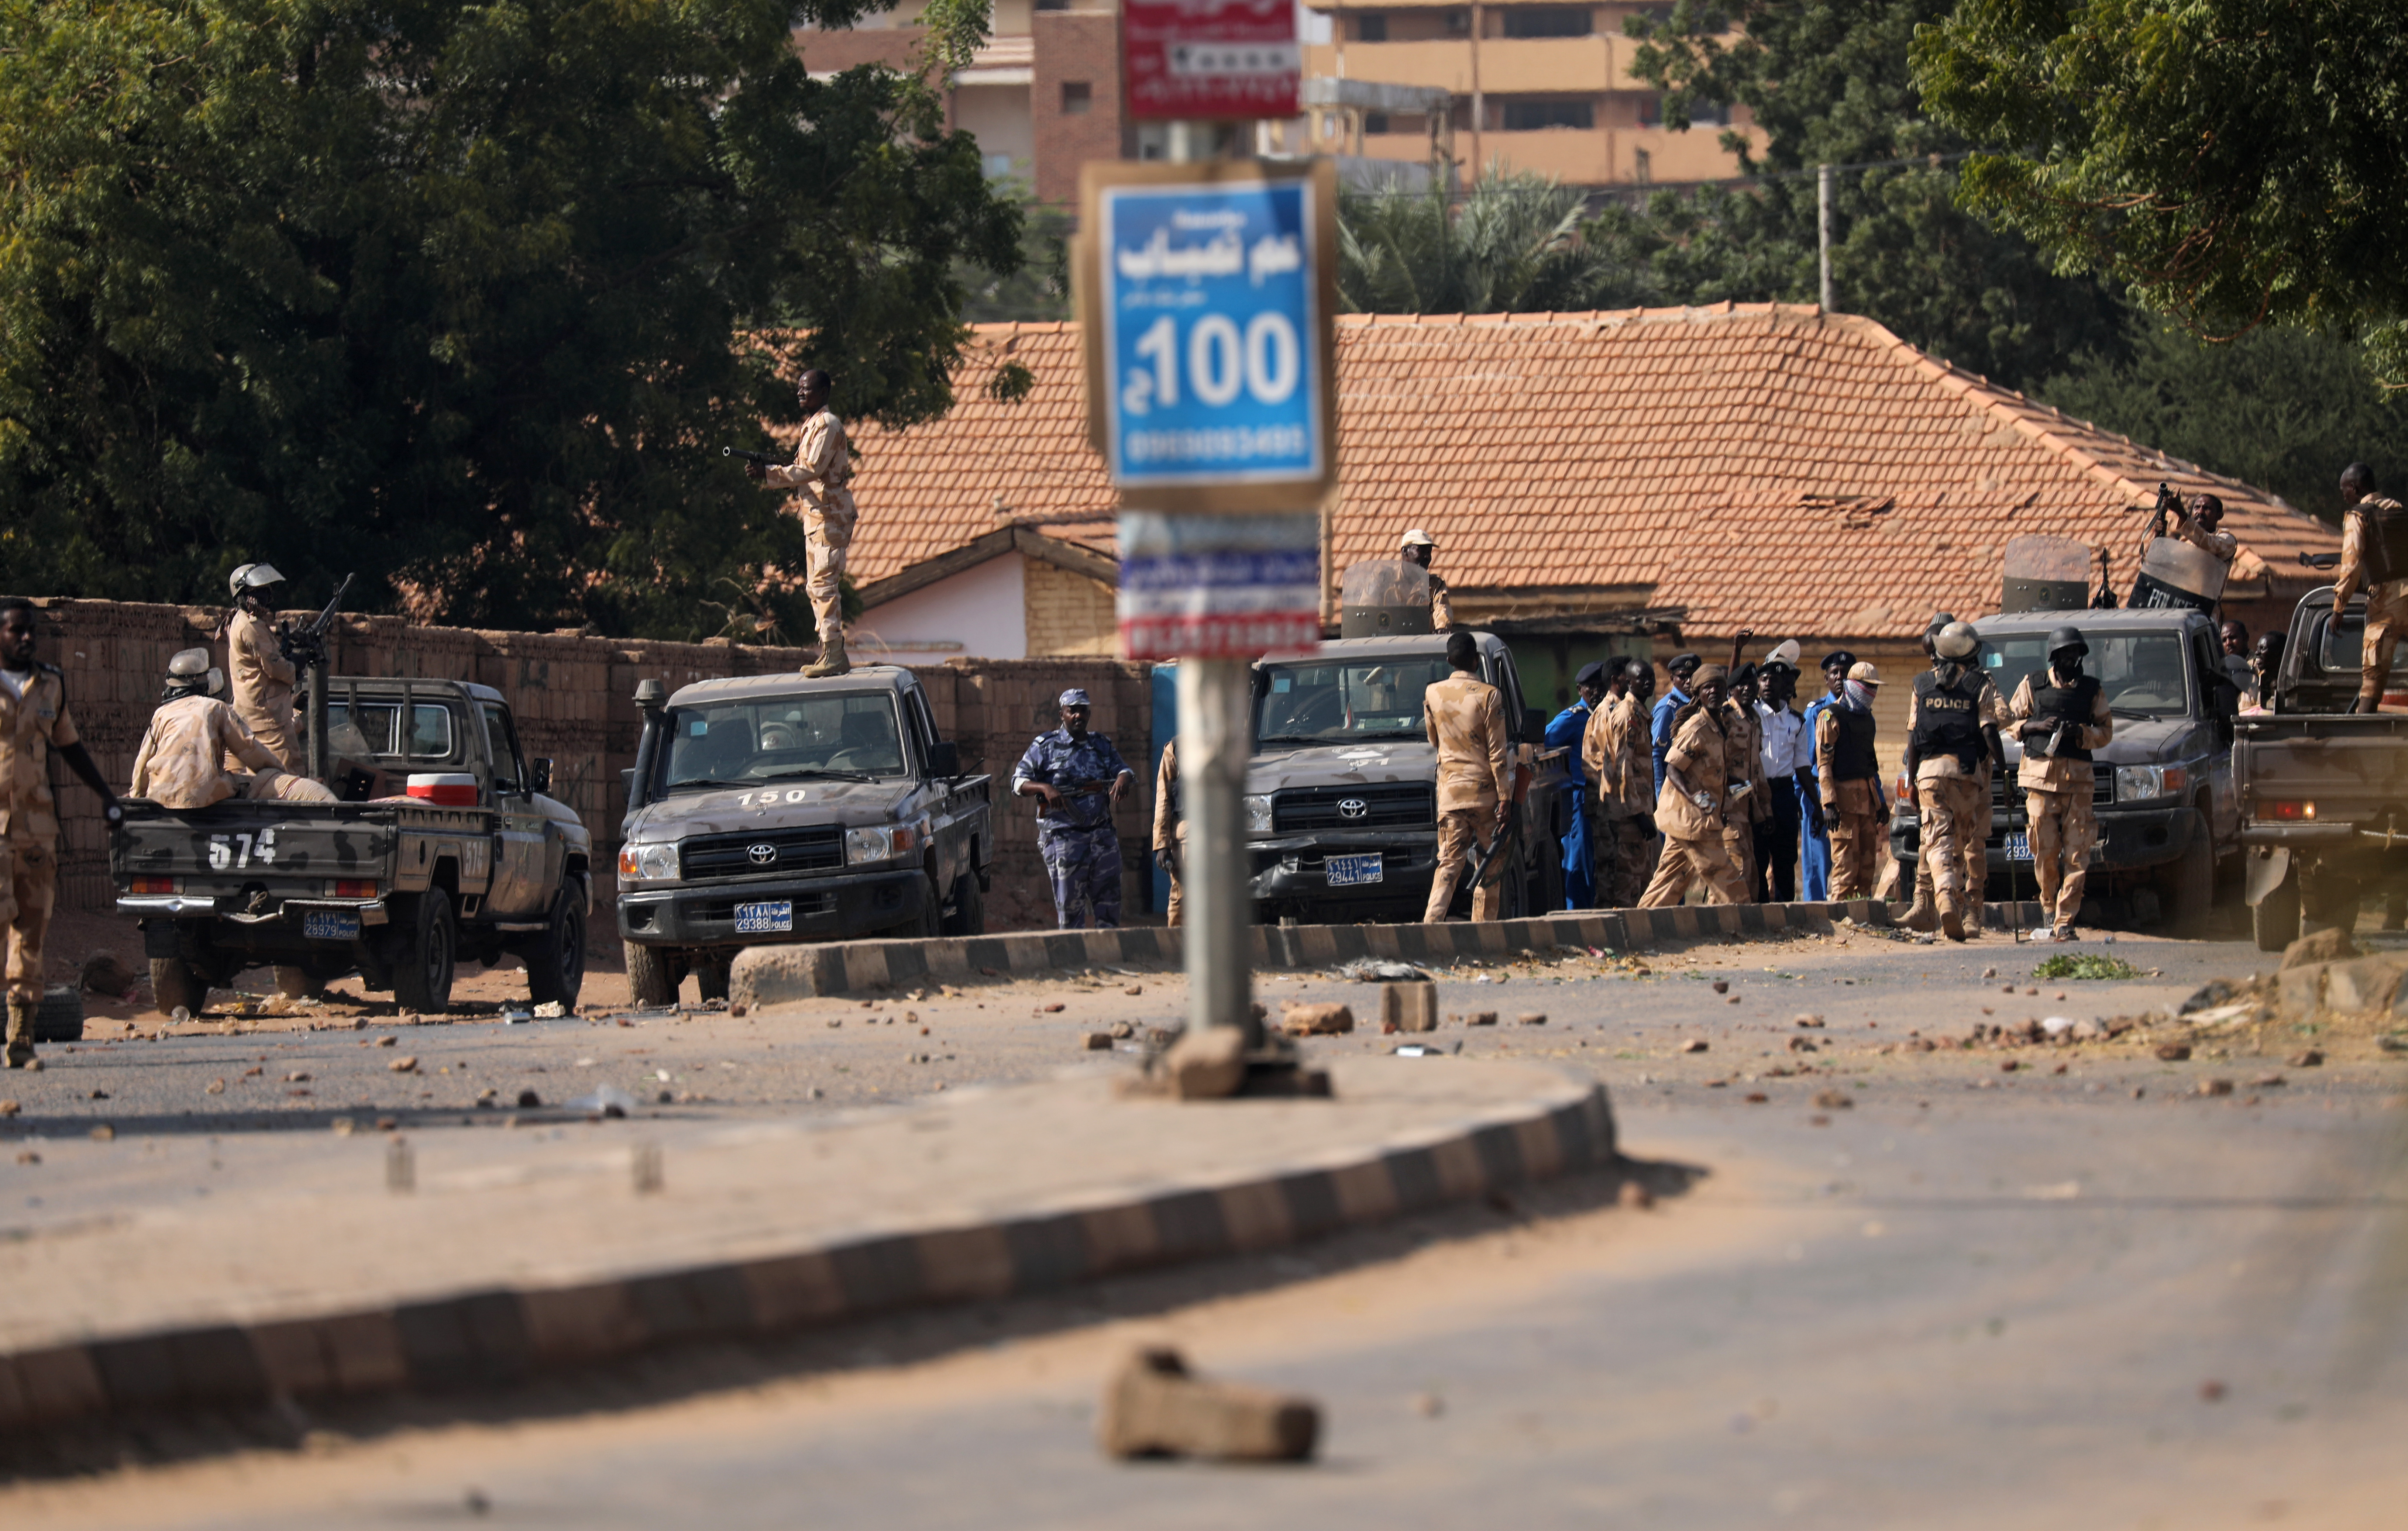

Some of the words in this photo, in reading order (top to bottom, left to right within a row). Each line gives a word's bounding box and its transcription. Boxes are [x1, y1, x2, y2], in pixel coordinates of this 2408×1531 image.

[1137, 312, 1298, 405] 100
[1926, 697, 1970, 710] POLICE
[737, 789, 806, 806] 150
[209, 828, 276, 870] 574
[2007, 845, 2033, 858] 2937
[1329, 869, 1360, 884] 29441
[1363, 872, 1381, 881] POLICE
[771, 907, 790, 917] الشرطة
[306, 924, 337, 936] 28979
[737, 917, 769, 930] 29388
[771, 920, 790, 929] POLICE
[339, 930, 358, 938] POLICE
